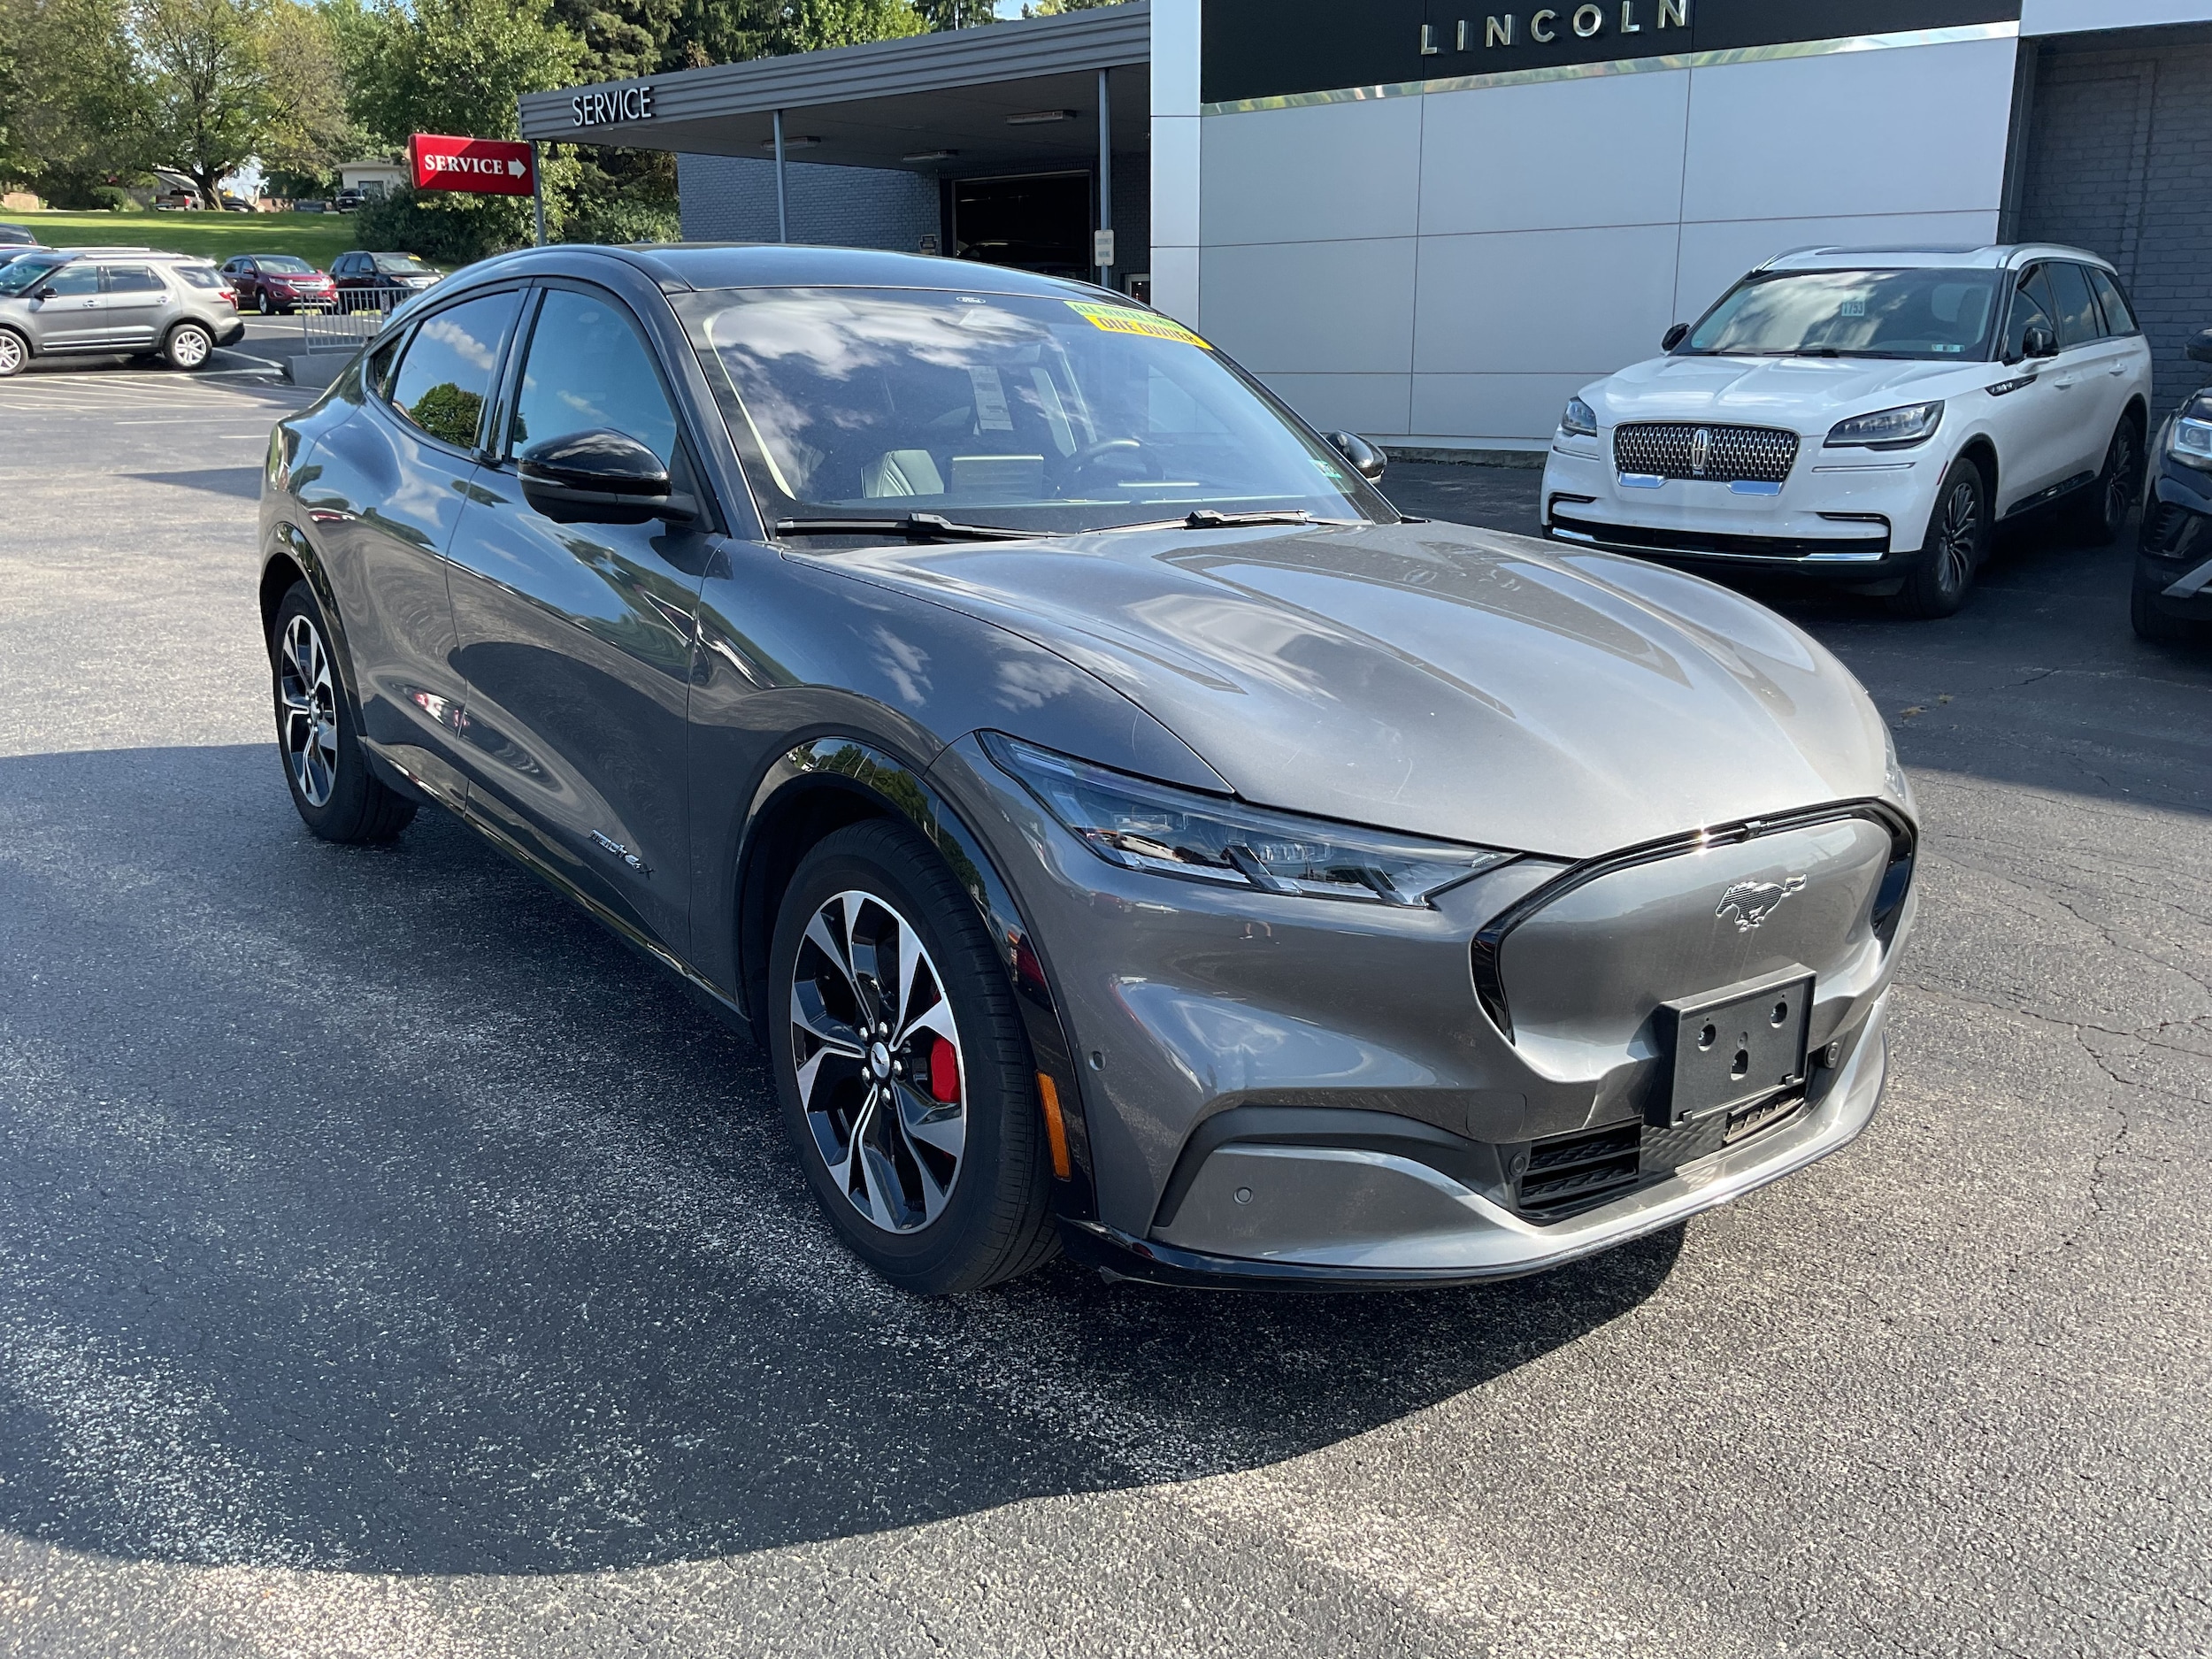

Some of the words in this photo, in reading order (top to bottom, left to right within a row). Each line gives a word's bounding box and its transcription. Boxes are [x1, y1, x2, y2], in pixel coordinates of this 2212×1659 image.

[1420, 0, 1688, 55] LINCOLN
[571, 86, 653, 127] SERVICE
[424, 153, 504, 175] SERVICE
[1097, 318, 1138, 332] ONE
[1139, 322, 1200, 344] OWNER
